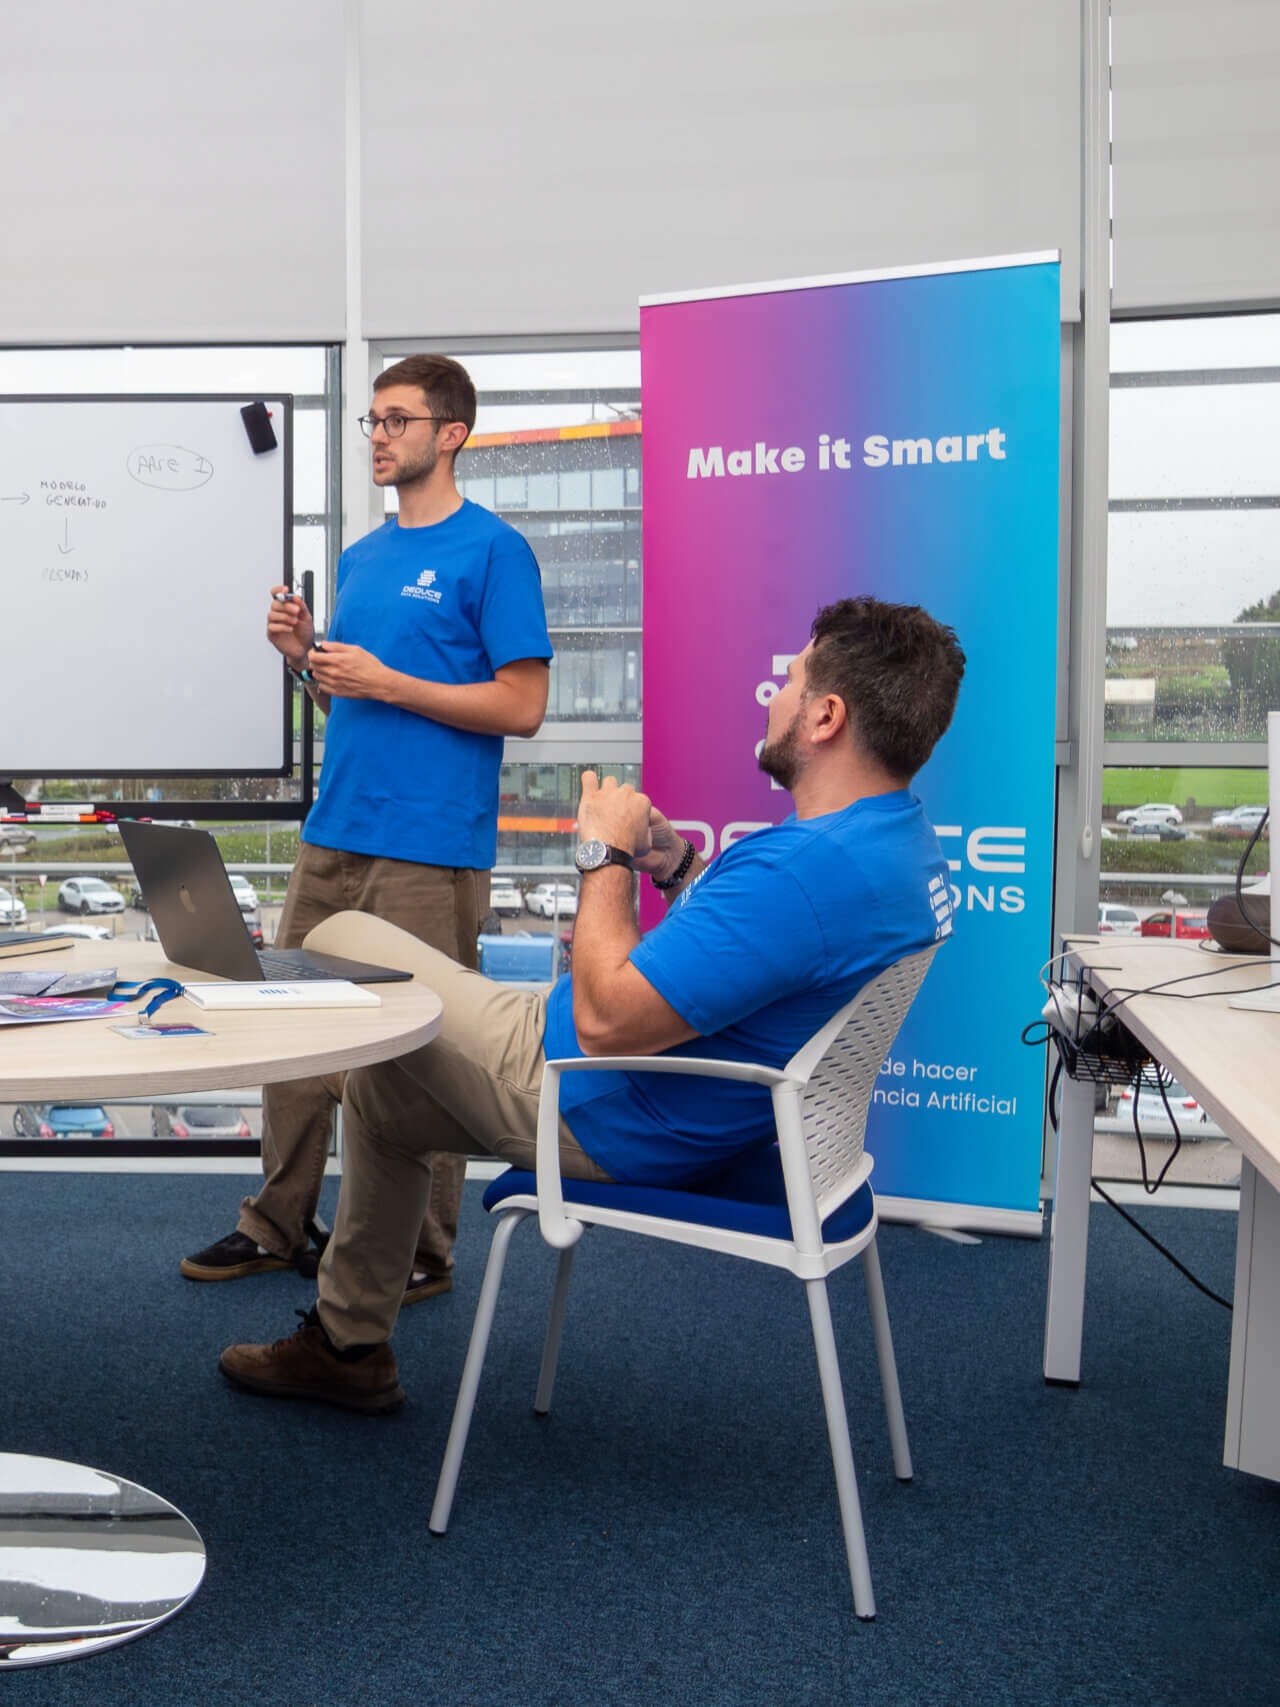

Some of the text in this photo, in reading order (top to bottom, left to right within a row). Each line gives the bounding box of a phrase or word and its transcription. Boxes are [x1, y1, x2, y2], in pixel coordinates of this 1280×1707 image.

[687, 427, 1006, 479] Make it Smart
[879, 1057, 977, 1082] de hacer
[927, 1091, 1017, 1116] Artificial
